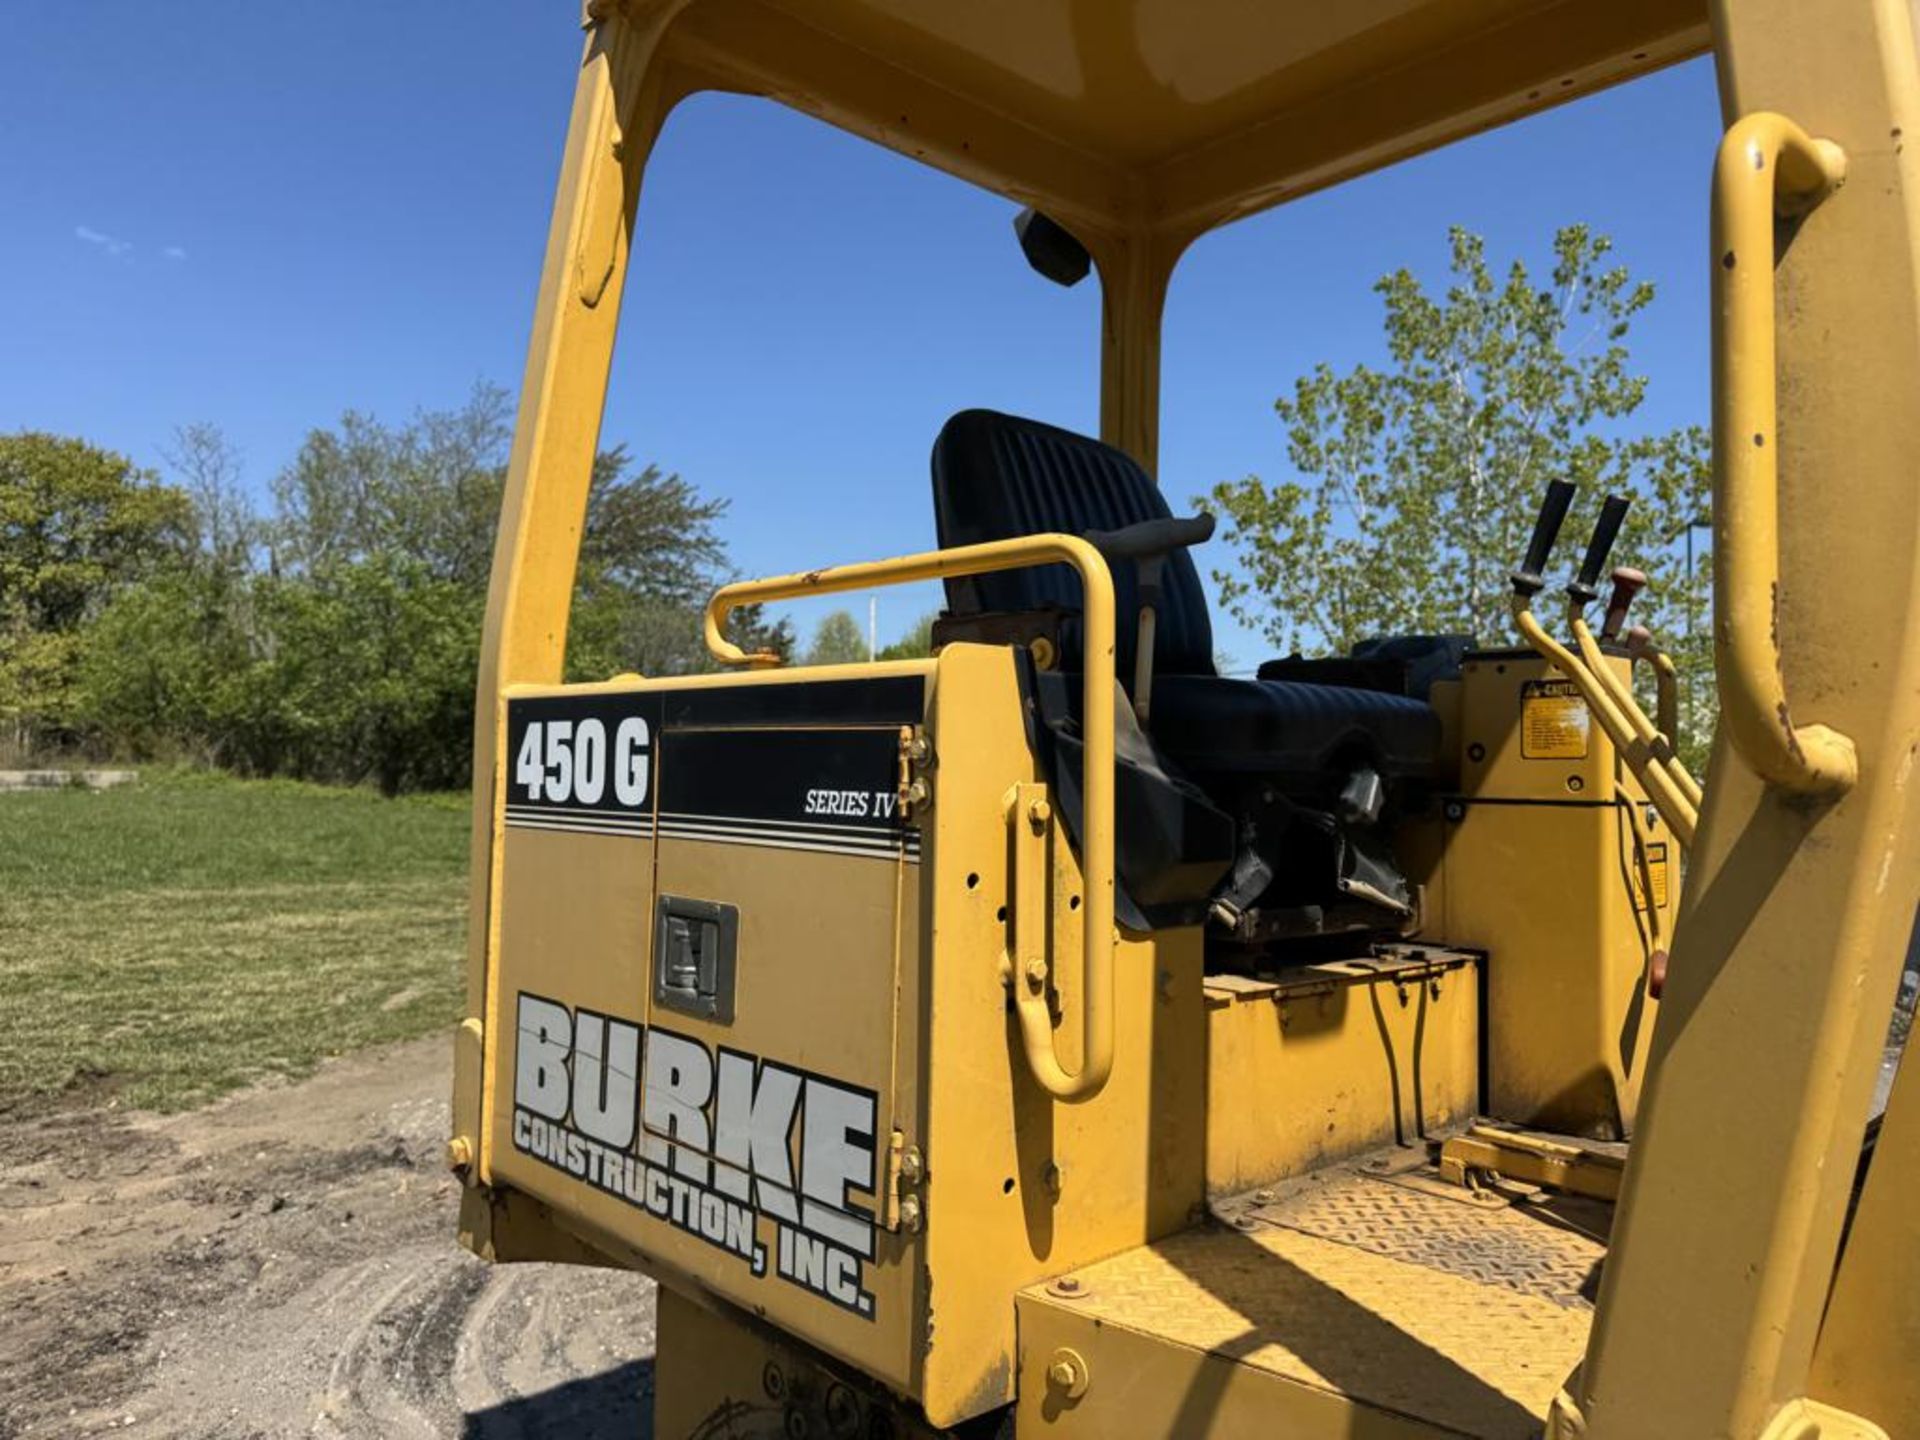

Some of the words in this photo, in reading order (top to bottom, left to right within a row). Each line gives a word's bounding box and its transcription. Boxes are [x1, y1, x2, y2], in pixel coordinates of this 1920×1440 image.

[1544, 683, 1580, 696] CAUTI
[515, 717, 605, 804] 450
[805, 789, 868, 816] SERIES
[872, 792, 898, 818] IV
[514, 990, 878, 1263] BURKE
[513, 1107, 768, 1278] CONSTRUCTION,
[777, 1222, 876, 1321] INC.
